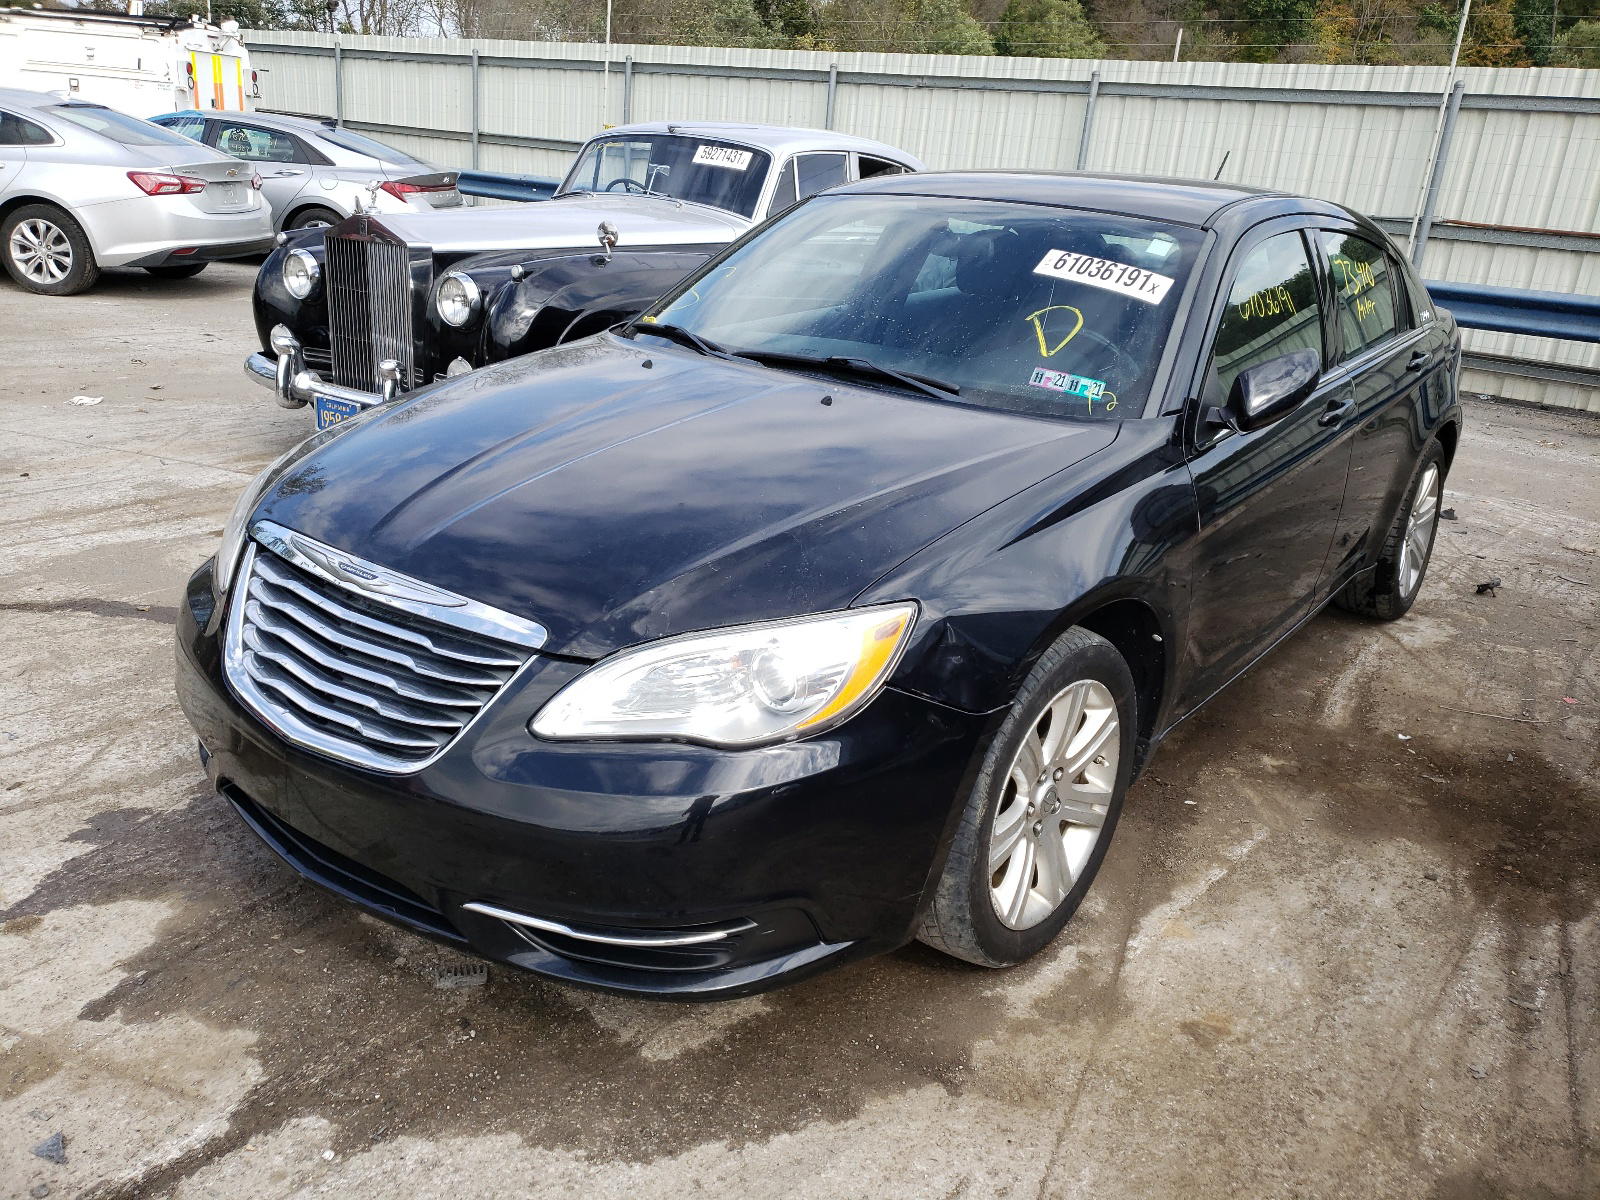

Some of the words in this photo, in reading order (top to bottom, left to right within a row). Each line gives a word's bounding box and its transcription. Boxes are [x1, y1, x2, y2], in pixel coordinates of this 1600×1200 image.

[1034, 372, 1044, 383] 11
[1054, 374, 1066, 387] 21
[1069, 380, 1079, 391] 11
